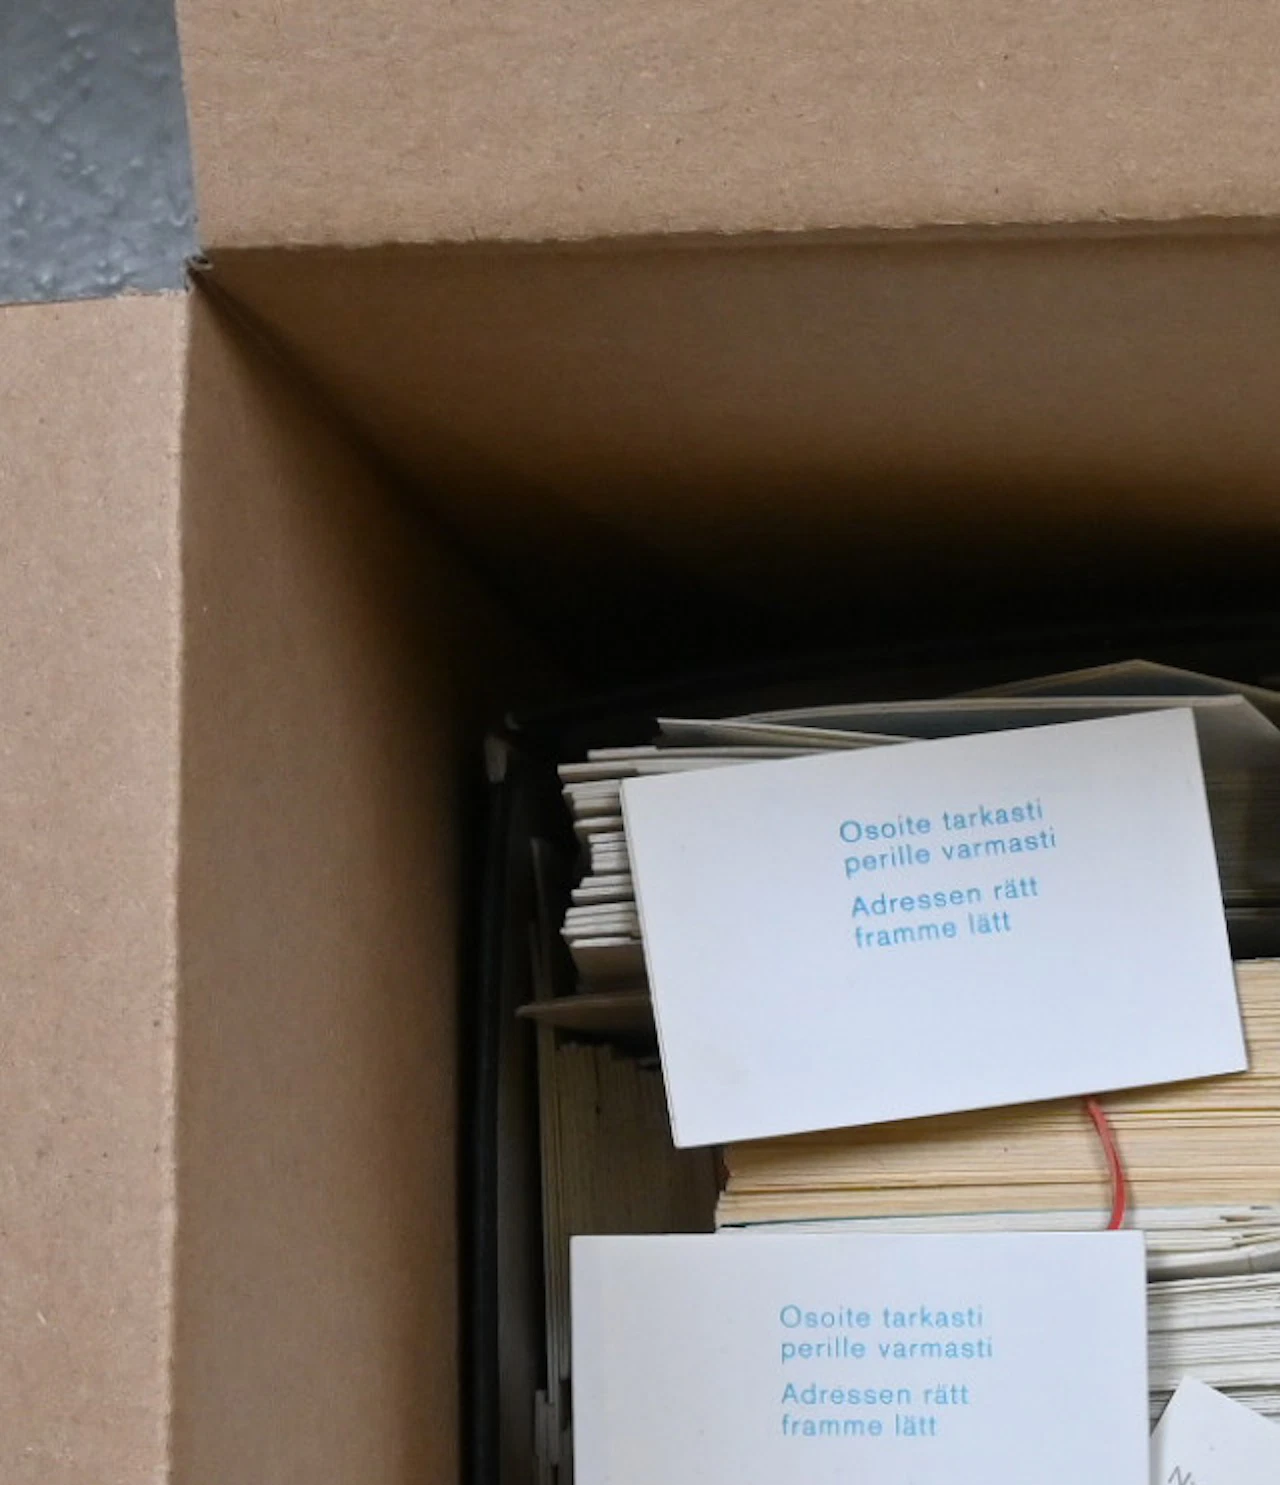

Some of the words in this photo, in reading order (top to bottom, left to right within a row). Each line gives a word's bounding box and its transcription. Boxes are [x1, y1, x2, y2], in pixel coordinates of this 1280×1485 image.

[839, 815, 932, 844] Osoite
[941, 797, 1044, 832] tarkasti
[843, 844, 932, 880] perille
[940, 826, 1057, 862] varmasti
[851, 886, 984, 920] Adressen
[992, 875, 1041, 902] rätt
[854, 920, 959, 949] framme
[967, 909, 1013, 936] lätt
[779, 1303, 873, 1329] Osoite
[881, 1304, 984, 1330] tarkasti
[780, 1335, 869, 1366] perille
[878, 1336, 993, 1361] varmasti
[780, 1381, 913, 1406] Adressen
[922, 1382, 971, 1406] rätt
[781, 1412, 885, 1438] framme
[895, 1412, 938, 1438] lätt
